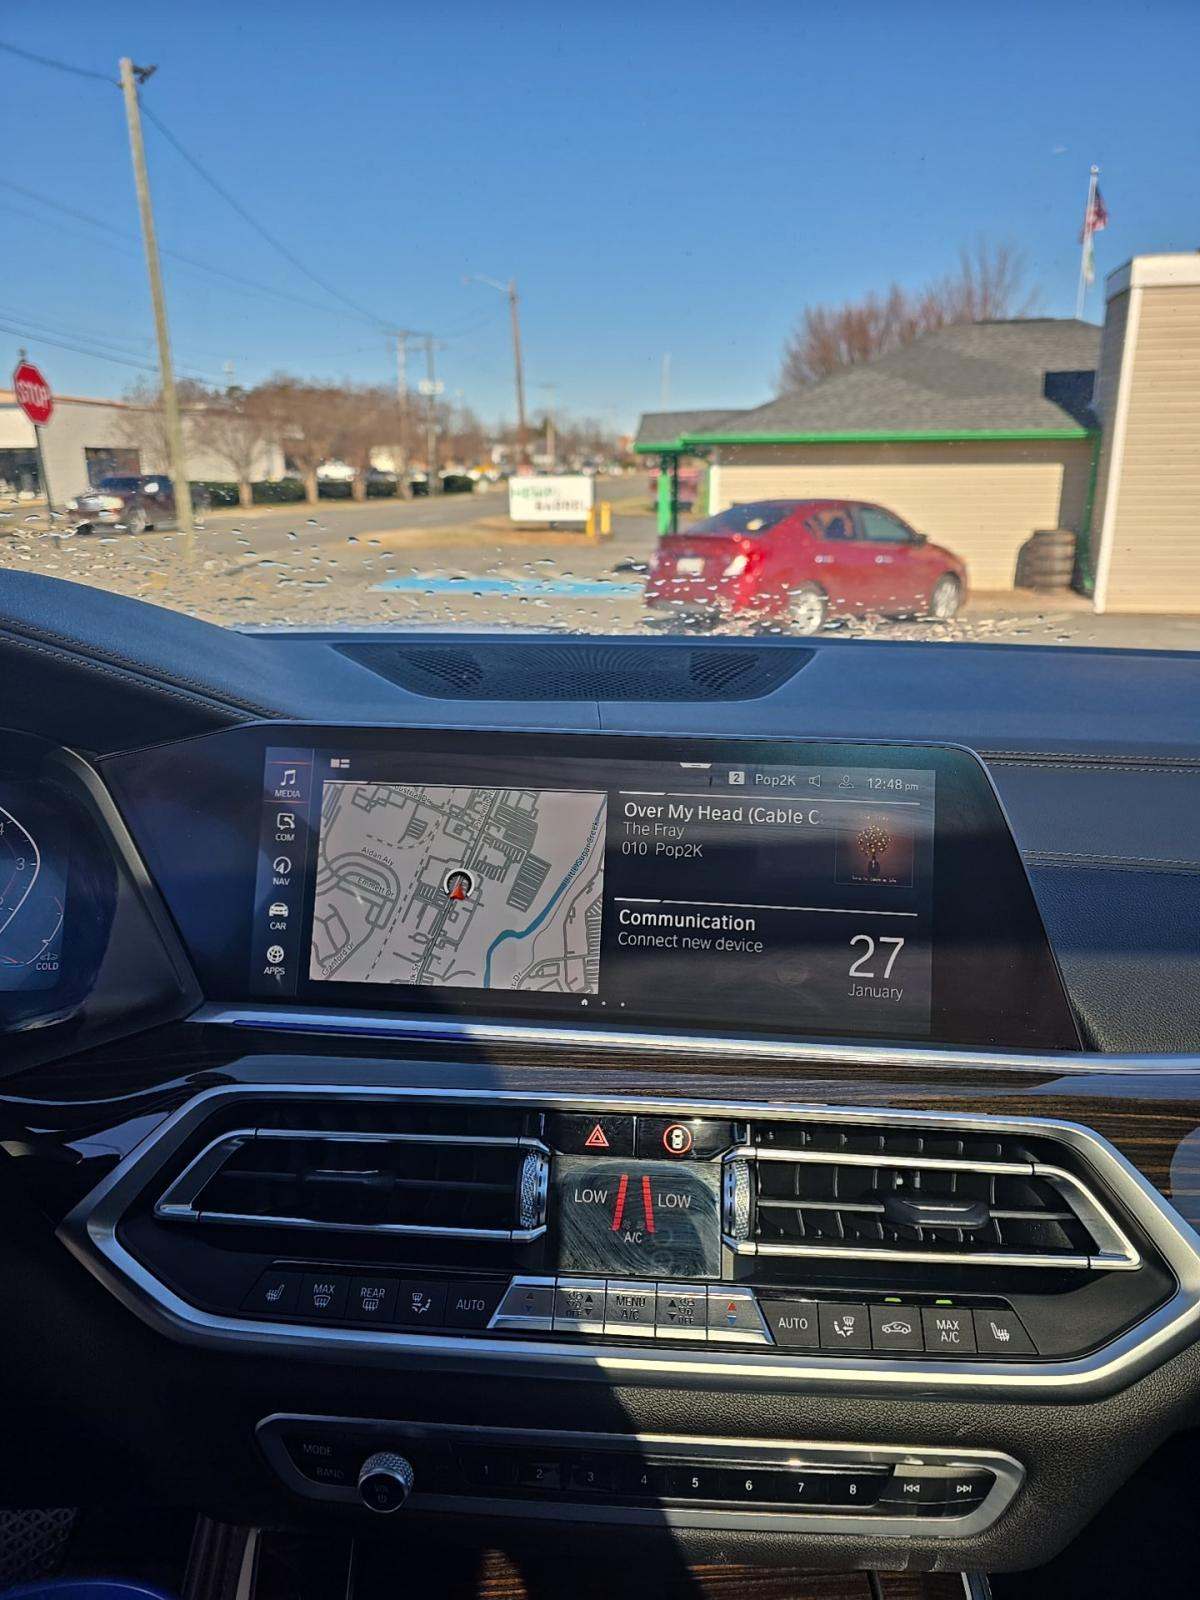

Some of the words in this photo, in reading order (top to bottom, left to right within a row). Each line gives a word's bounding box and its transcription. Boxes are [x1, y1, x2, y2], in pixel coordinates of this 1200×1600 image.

[17, 380, 50, 409] STOP
[755, 773, 797, 788] Pop2K
[867, 777, 902, 791] 12:48
[904, 782, 919, 792] pm
[274, 789, 301, 798] MEDIA
[624, 802, 664, 819] Over
[668, 804, 694, 822] My
[698, 805, 743, 822] Head
[748, 807, 803, 825] (Cable
[623, 821, 650, 836] The
[654, 823, 685, 840] Fray
[275, 833, 295, 842] COM
[621, 841, 648, 856] 010
[655, 842, 703, 860] Pop2K
[16, 857, 25, 871] 3
[272, 877, 290, 886] NAV
[269, 921, 287, 931] CAR
[618, 908, 756, 932] Communication
[617, 931, 679, 950] Connect
[682, 936, 712, 951] new
[715, 936, 764, 954] device
[848, 934, 906, 980] 27
[36, 962, 59, 971] COLD
[263, 966, 286, 976] APPS
[848, 983, 904, 1002] January
[574, 1188, 608, 1204] LOW
[658, 1193, 692, 1209] LOW
[623, 1231, 642, 1244] A/C
[313, 1283, 335, 1295] MAX
[360, 1287, 386, 1299] REAR
[455, 1299, 485, 1311] AUTO
[616, 1294, 647, 1308] MENU
[620, 1309, 640, 1321] A/C
[778, 1317, 809, 1330] AUTO
[936, 1319, 960, 1331] MAX
[940, 1331, 960, 1344] A/C
[303, 1443, 333, 1457] MODE
[536, 1468, 543, 1480] 2
[587, 1471, 594, 1483] 3
[640, 1474, 647, 1486] 4
[691, 1477, 699, 1489] 5
[745, 1480, 752, 1492] 6
[798, 1482, 804, 1494] 7
[849, 1484, 857, 1496] 8
